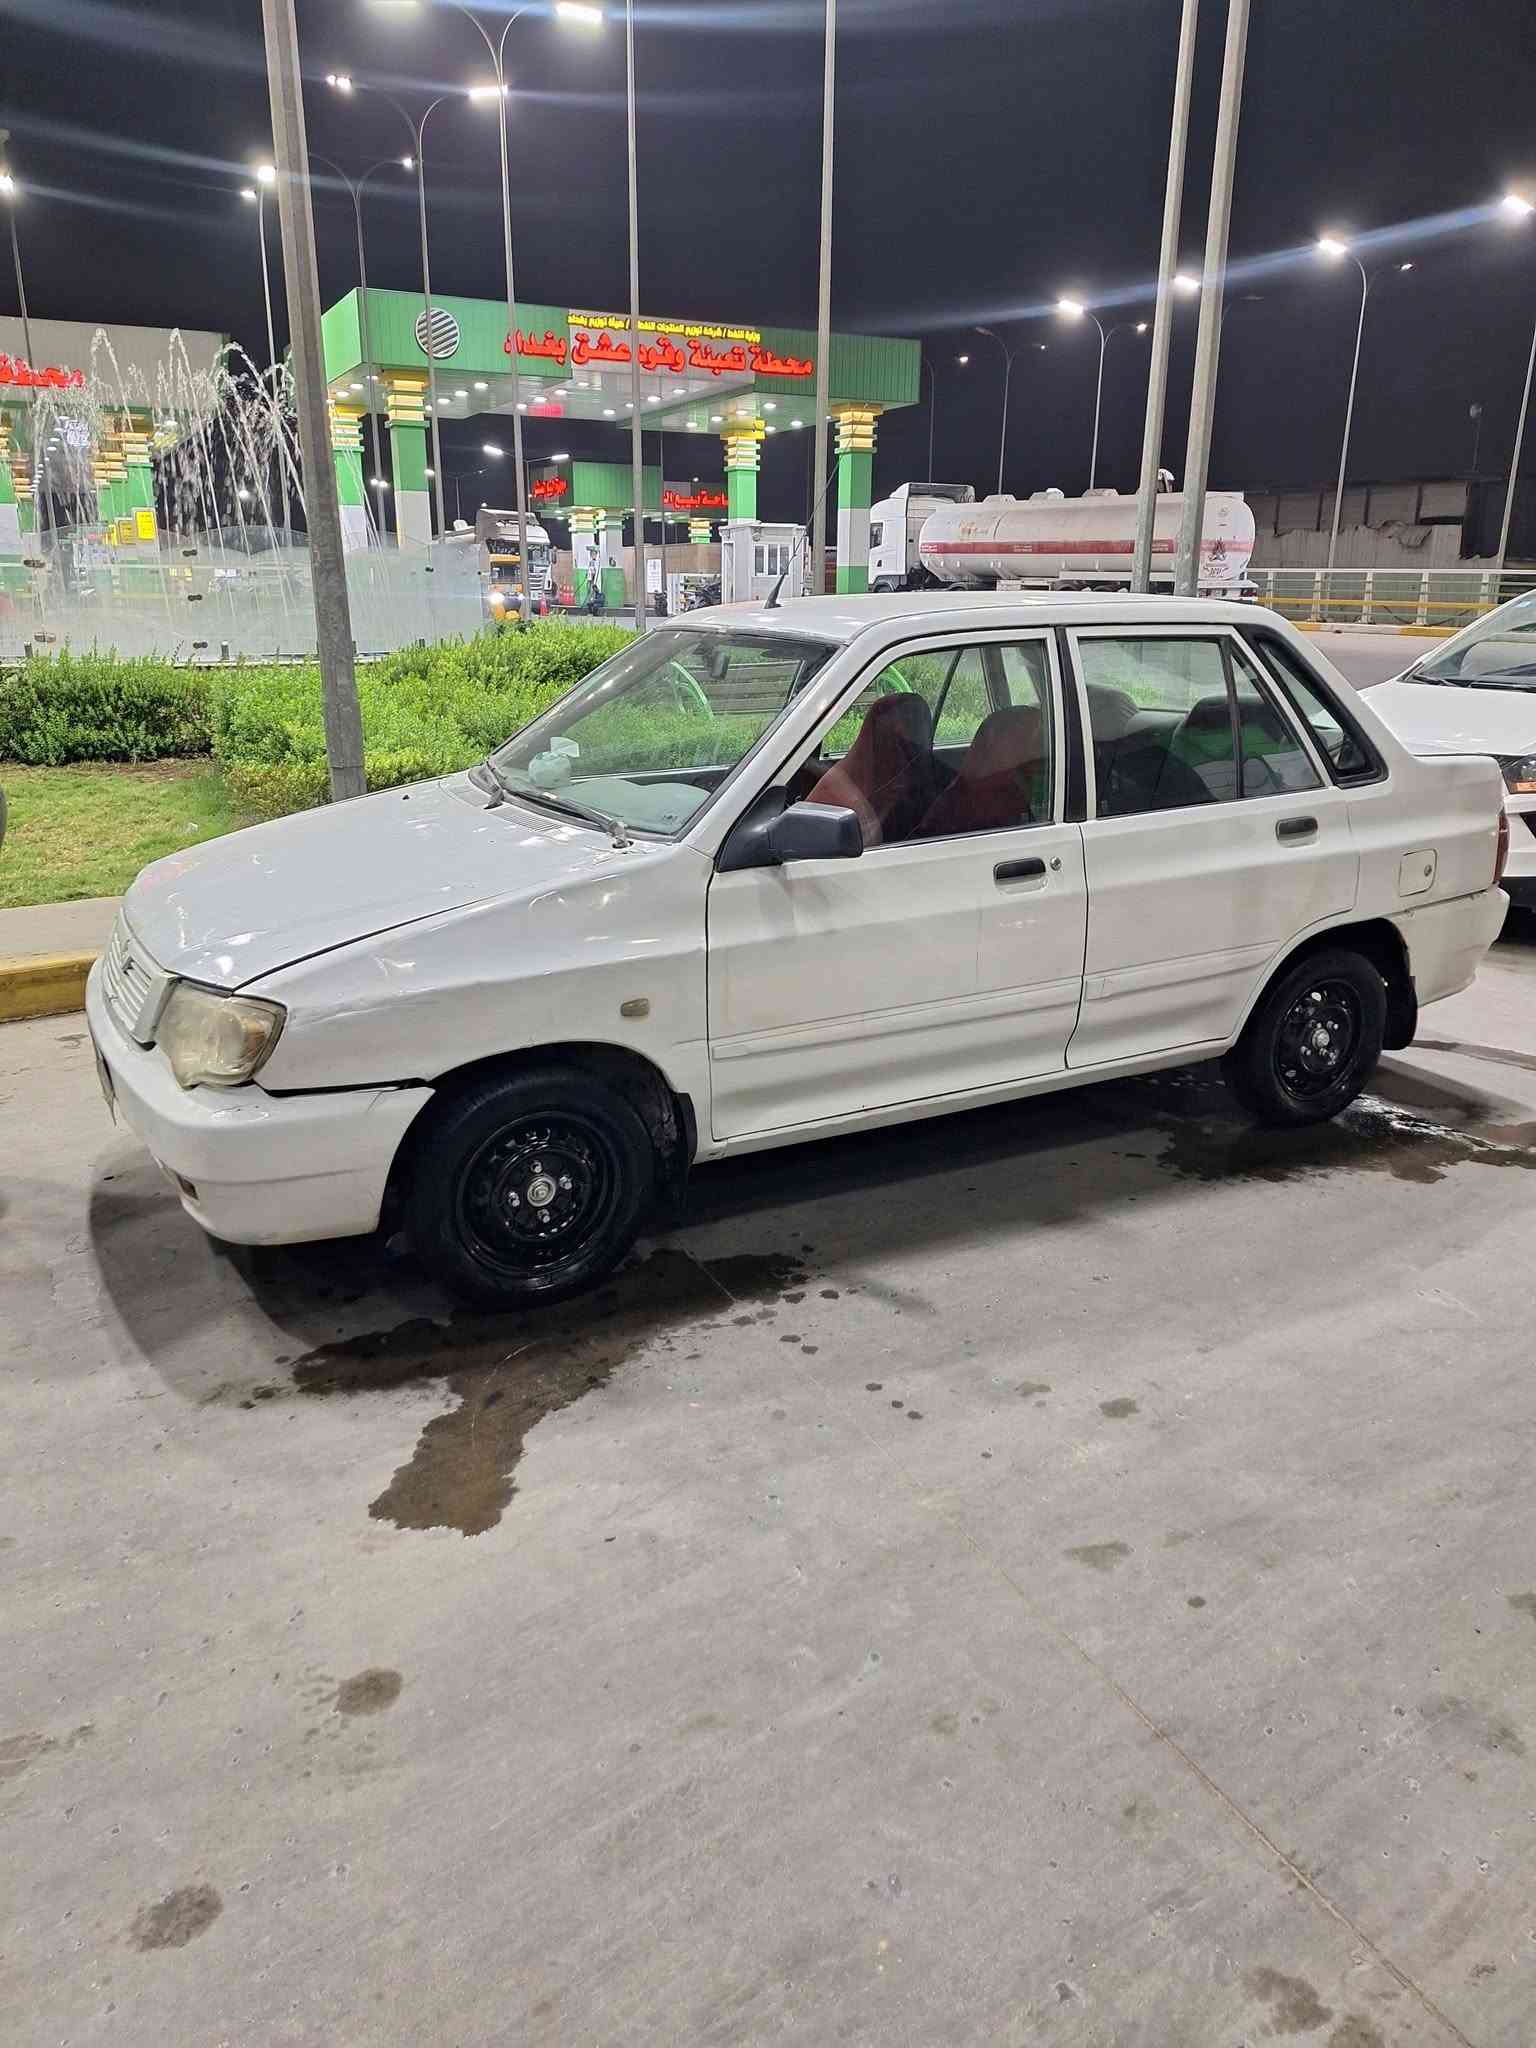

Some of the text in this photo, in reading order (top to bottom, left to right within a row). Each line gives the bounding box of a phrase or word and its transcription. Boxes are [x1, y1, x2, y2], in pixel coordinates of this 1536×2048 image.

[567, 313, 588, 327] بغداد
[589, 316, 607, 328] توزيع
[685, 325, 702, 337] توزيع
[703, 326, 722, 338] شركة
[727, 328, 744, 340] النفط
[744, 329, 761, 343] وزارة
[504, 329, 814, 375] محطة تعبئة وقود عشق بغداد
[702, 488, 729, 506] احة
